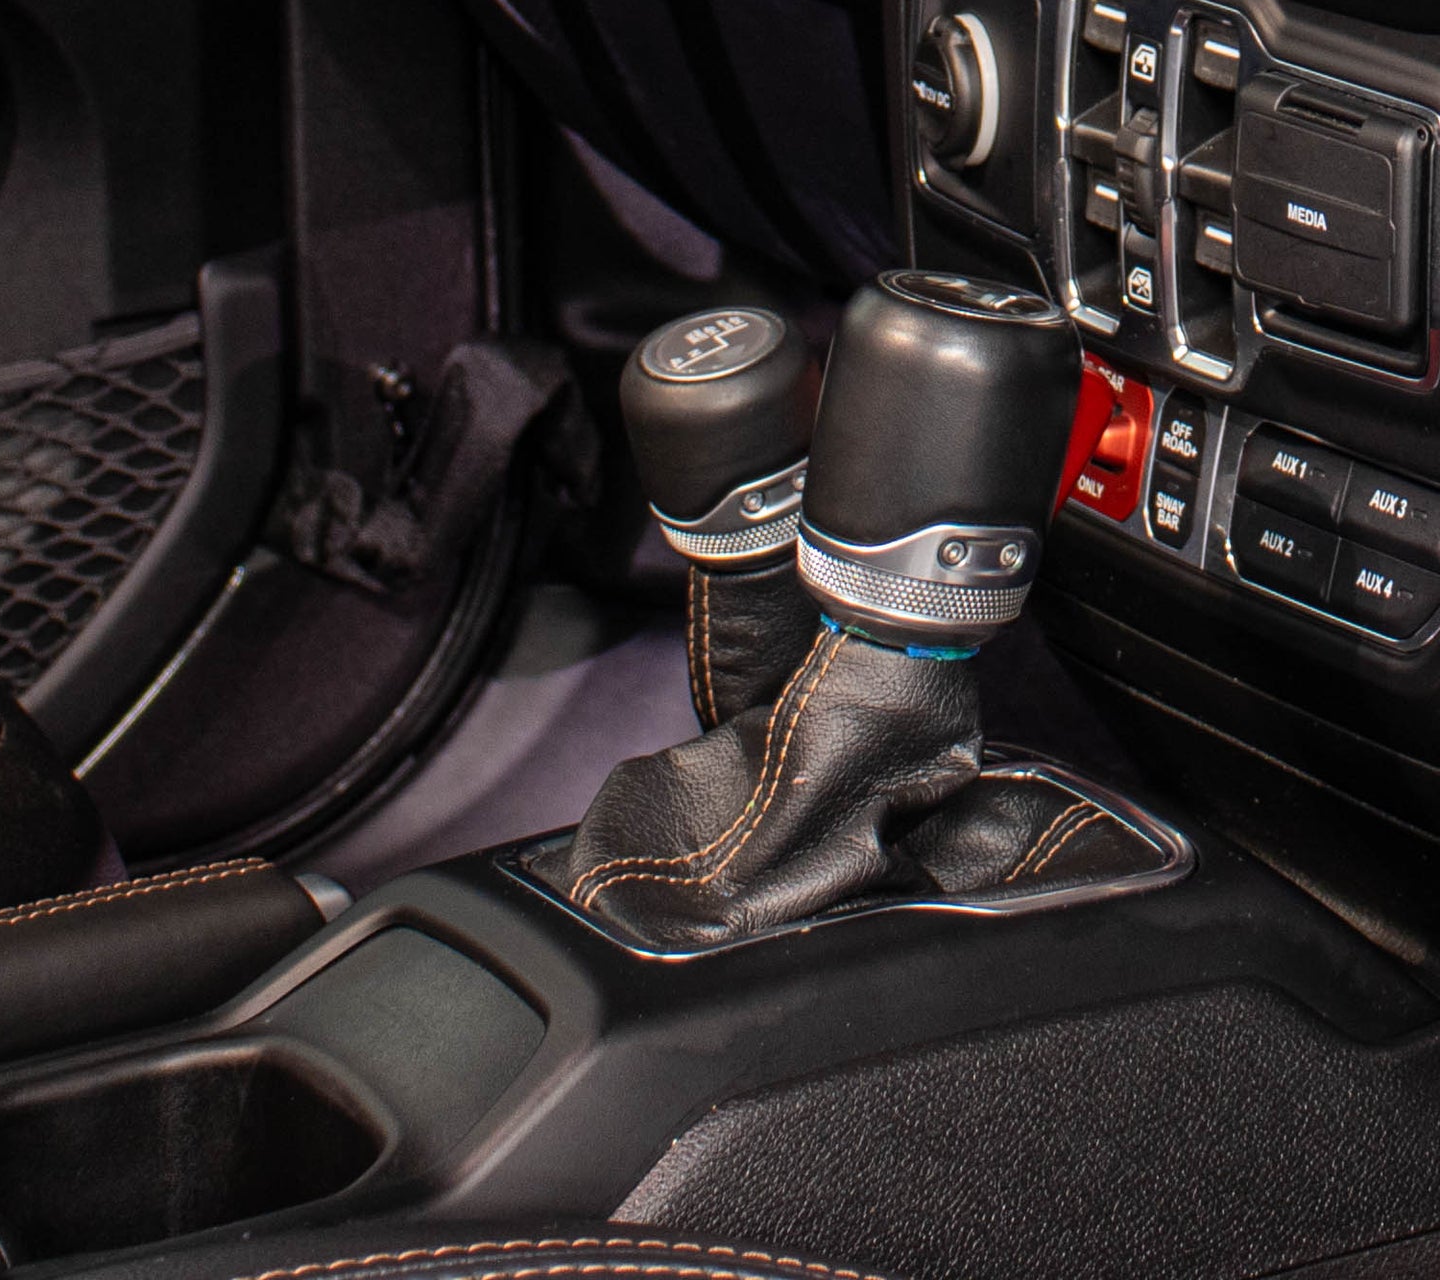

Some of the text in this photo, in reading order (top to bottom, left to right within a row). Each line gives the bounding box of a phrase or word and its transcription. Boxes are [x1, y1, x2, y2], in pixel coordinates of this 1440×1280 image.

[1287, 202, 1328, 232] MEDIA
[1170, 419, 1194, 438] OFF
[1161, 432, 1198, 459] ROAD+
[1271, 451, 1300, 476] AUX
[1076, 474, 1105, 499] ONLY
[1155, 491, 1186, 516] SWAY
[1368, 489, 1408, 519] AUX 3
[1157, 508, 1180, 532] BAR
[1259, 529, 1295, 558] AUX 2
[1355, 568, 1394, 599] AUX 4
